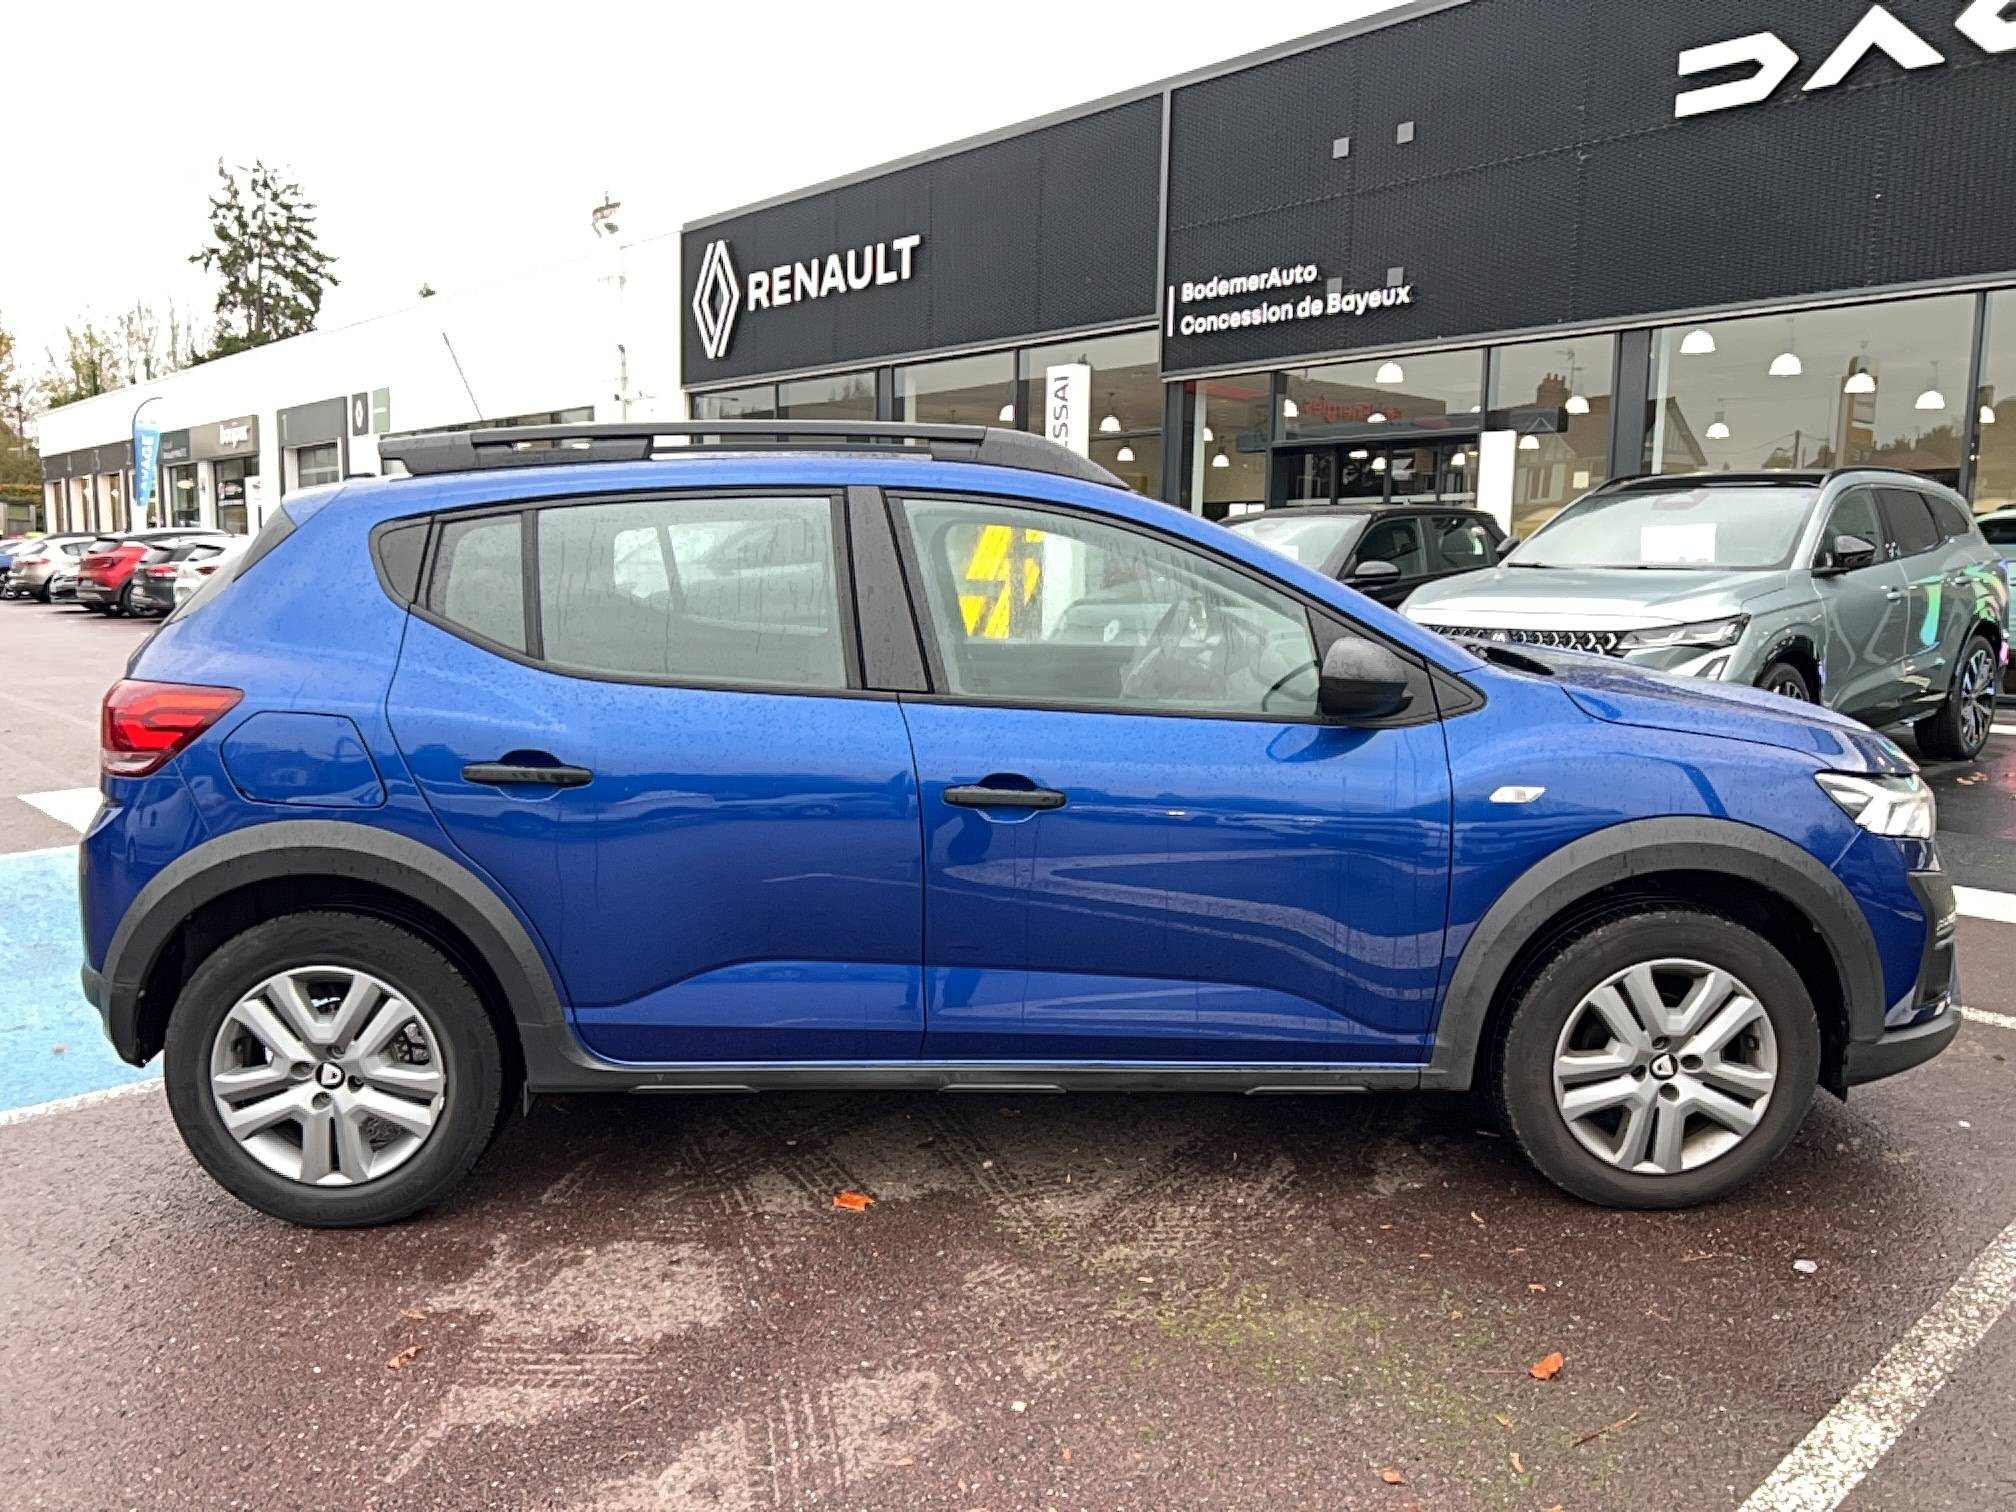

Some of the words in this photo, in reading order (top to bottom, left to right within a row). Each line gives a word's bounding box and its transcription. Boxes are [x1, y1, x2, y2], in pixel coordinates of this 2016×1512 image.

[748, 234, 921, 311] RENAULT
[1181, 263, 1318, 302] BodemerAuto
[1180, 301, 1293, 335] Concession
[1296, 296, 1324, 319] de
[1326, 285, 1411, 316] Bayeux
[1052, 376, 1070, 448] SSAI
